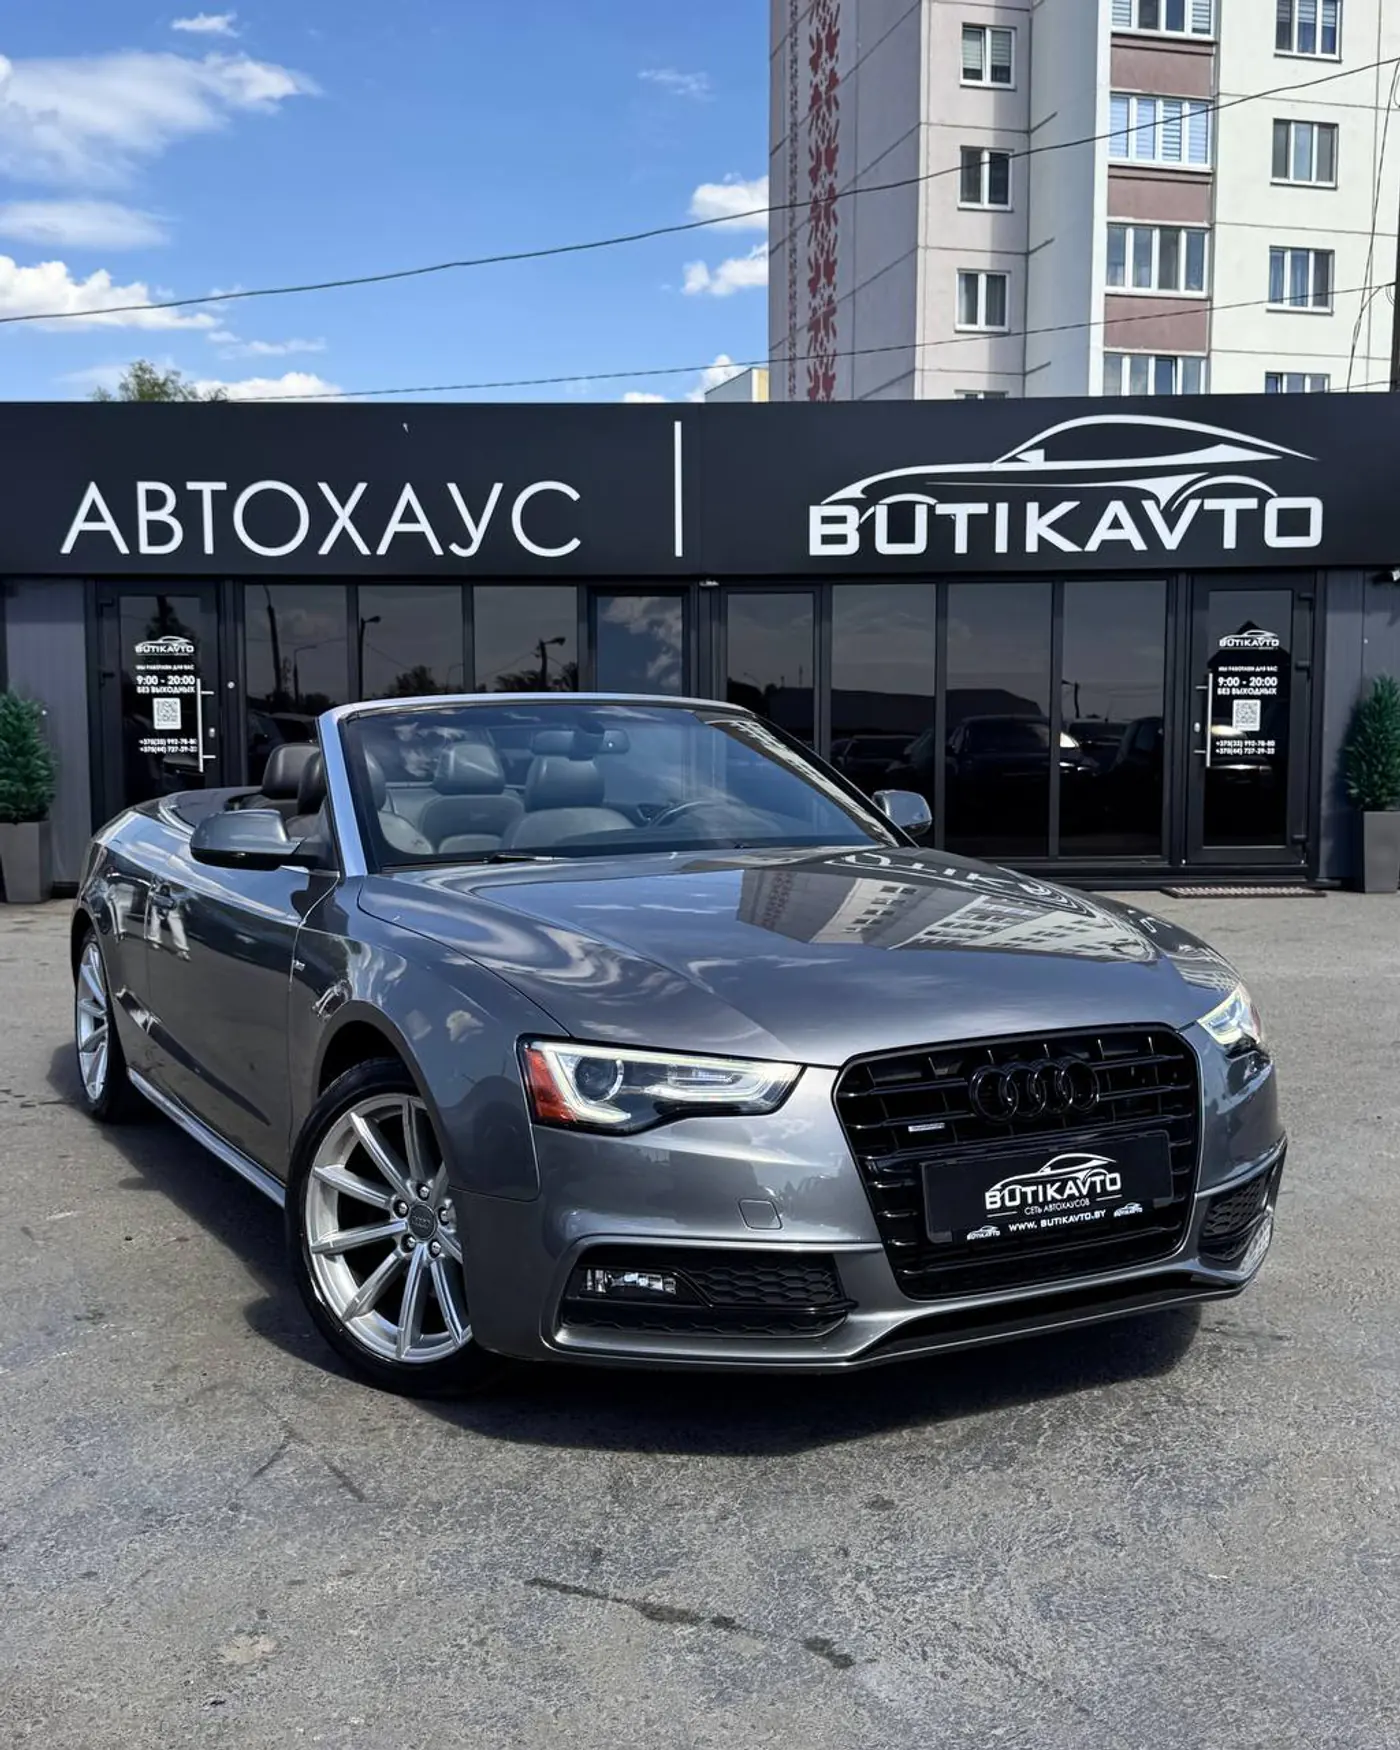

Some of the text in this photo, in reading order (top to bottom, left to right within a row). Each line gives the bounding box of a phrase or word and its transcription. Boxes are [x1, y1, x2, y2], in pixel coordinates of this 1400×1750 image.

[60, 480, 582, 557] АВТОХАУС
[808, 496, 1324, 556] BUTIKAVTO
[136, 675, 159, 685] 9:00
[167, 675, 195, 685] 20:00
[1218, 676, 1240, 687] 9:00
[1249, 676, 1278, 687] 20:00
[151, 686, 195, 694] ВЫХОДНЫХ
[1217, 687, 1277, 696] БЕЗ ВЫХОДНЫХ
[984, 1172, 1122, 1210] BUTIKAVTO
[1024, 1198, 1091, 1216] СЕТЬ АВТОХАУСОВ
[1008, 1209, 1107, 1232] WWW. BUTIKAVTO.BY
